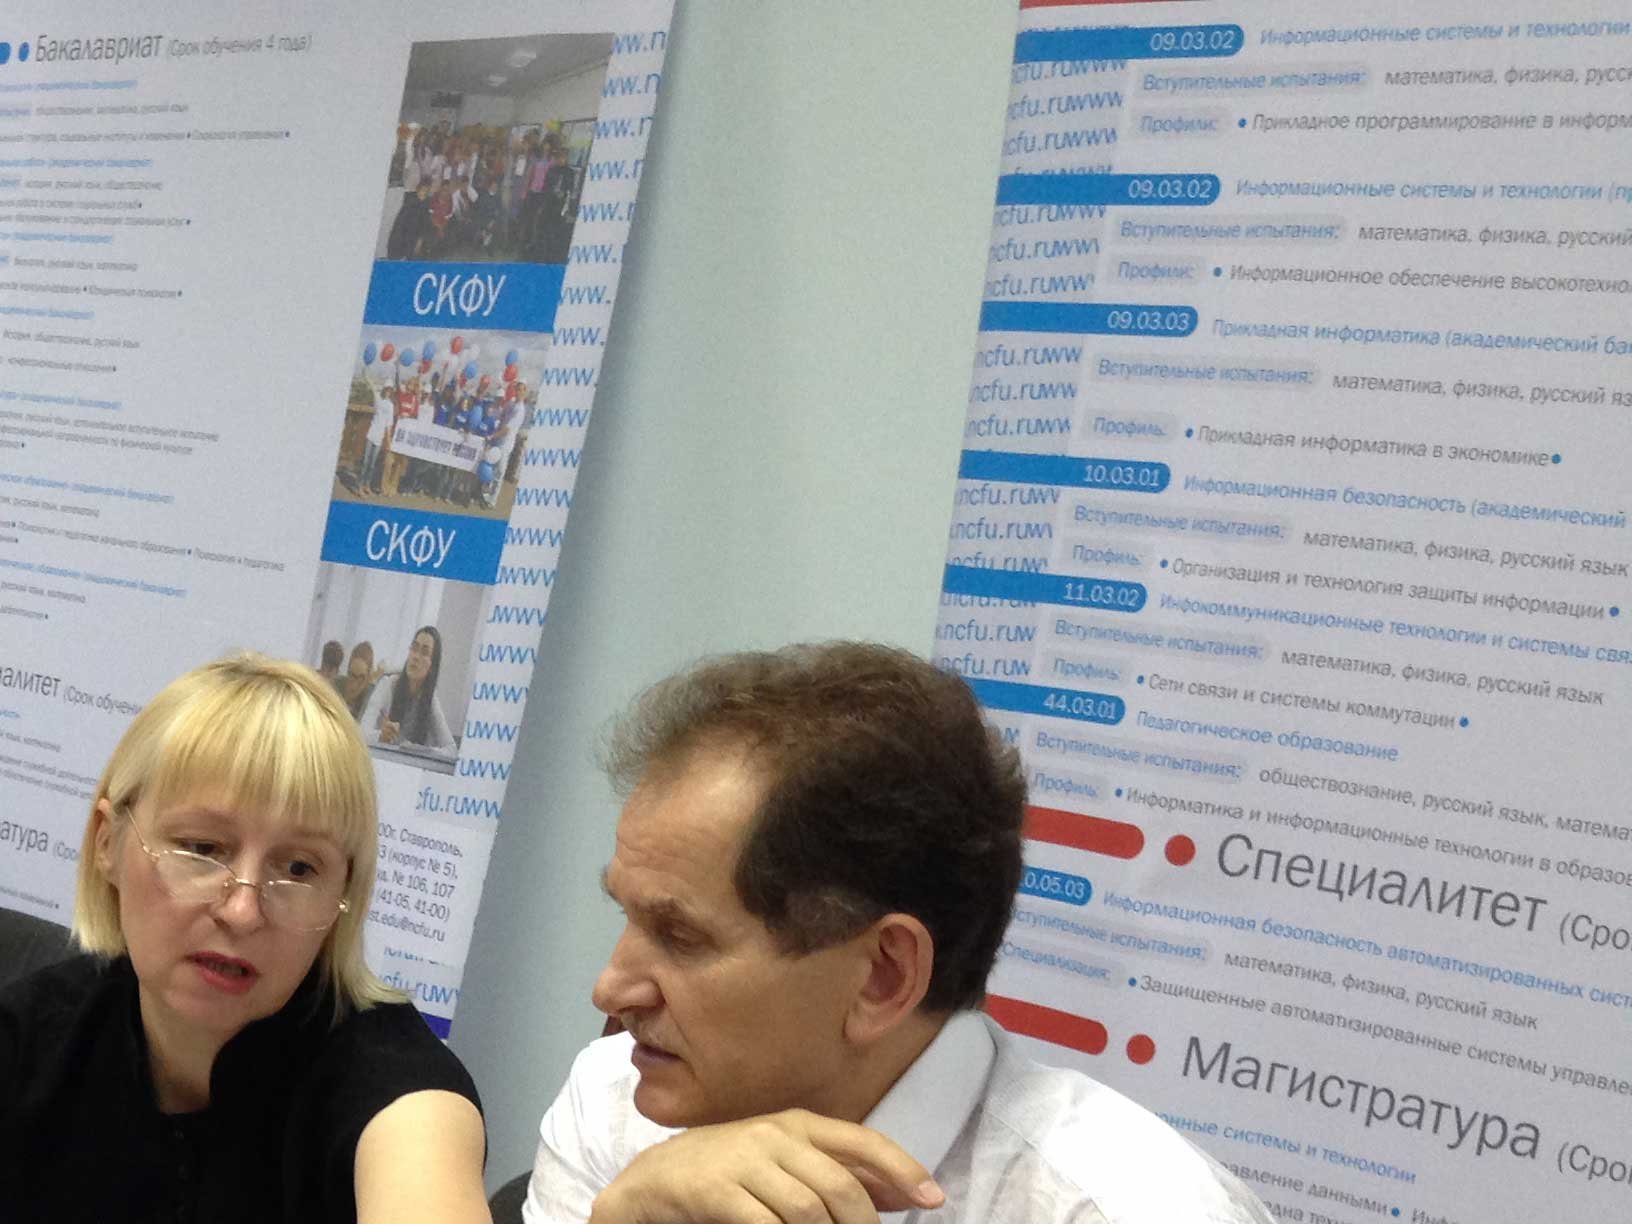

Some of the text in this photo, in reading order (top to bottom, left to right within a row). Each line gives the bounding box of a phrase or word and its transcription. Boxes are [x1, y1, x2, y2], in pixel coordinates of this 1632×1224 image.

[35, 34, 164, 64] Бакалавриат
[1150, 31, 1235, 51] 09.03.02
[1507, 24, 1521, 38] и
[1128, 178, 1212, 199] 09.03.02
[413, 273, 507, 316] СКФУ
[1107, 311, 1189, 331] 09.03.03
[1432, 443, 1443, 457] в
[1083, 463, 1160, 487] 10.03.01
[366, 519, 456, 567] СКФУ
[1285, 572, 1298, 585] и
[1064, 582, 1139, 607] 11.03.02
[1492, 634, 1502, 648] и
[1044, 692, 1117, 721] 44.03.01
[1243, 688, 1256, 702] и
[1249, 810, 1260, 822] и
[1539, 858, 1550, 871] в
[432, 882, 456, 899] 107
[1020, 871, 1085, 900] 0.05.03
[1218, 833, 1632, 951] Специалитет (Сро
[1181, 1035, 1542, 1160] Магистратура
[1306, 1143, 1318, 1157] и
